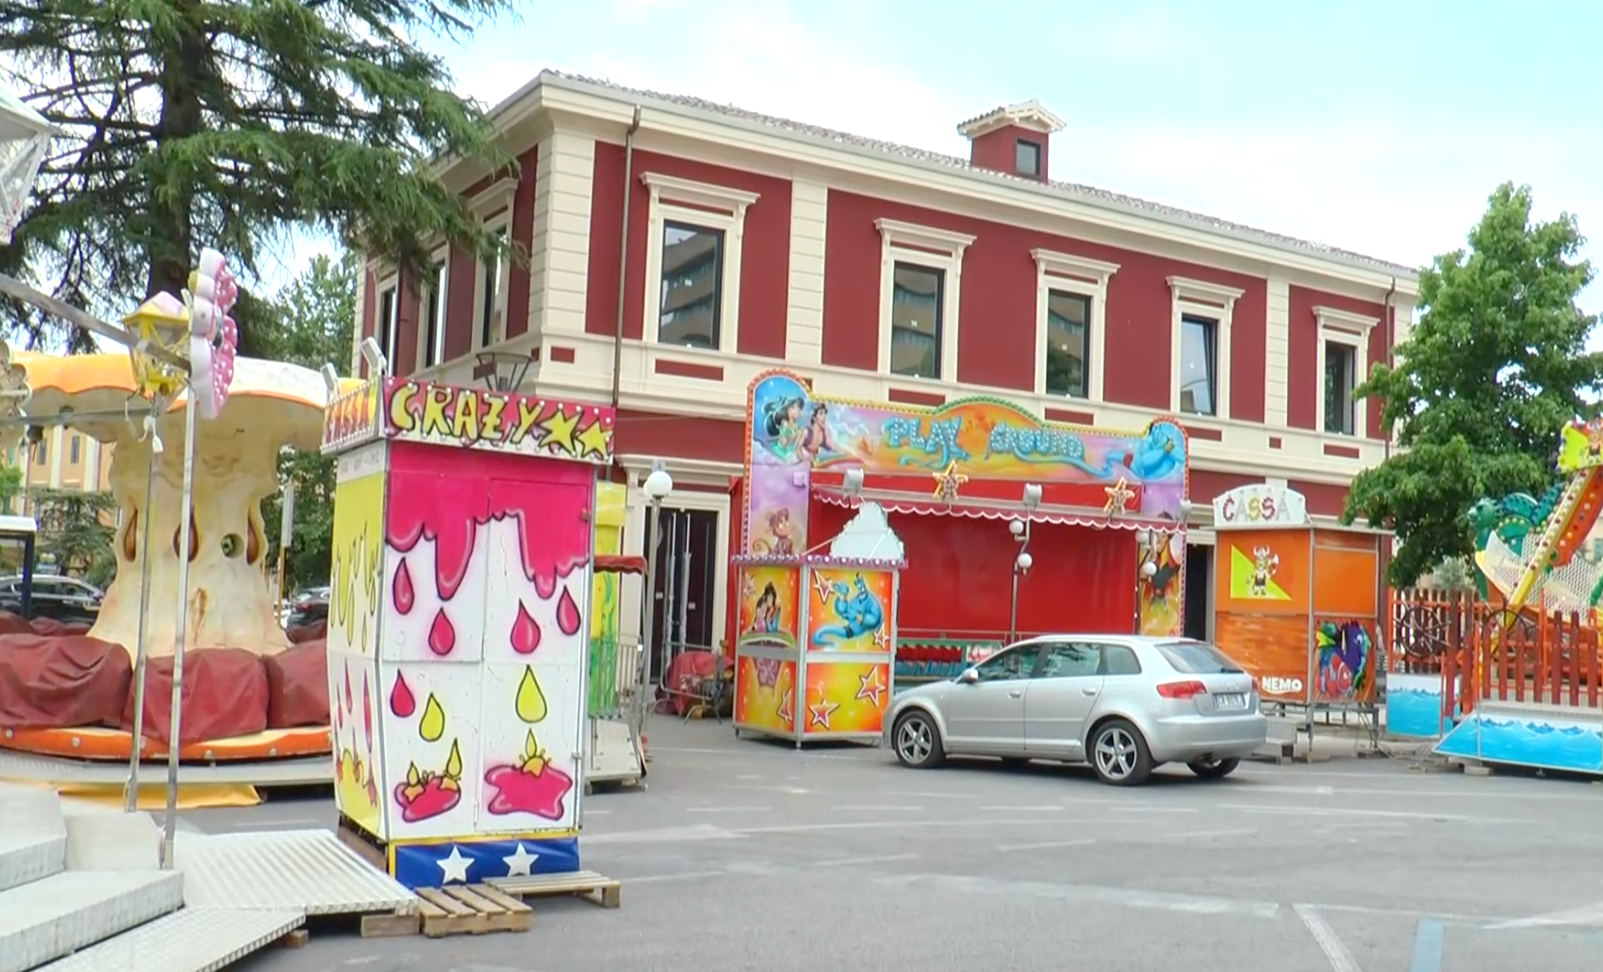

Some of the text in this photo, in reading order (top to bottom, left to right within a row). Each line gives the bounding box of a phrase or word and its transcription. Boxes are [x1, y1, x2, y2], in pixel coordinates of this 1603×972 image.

[390, 382, 545, 445] CRAZY
[880, 415, 1085, 461] PLAY GROUND
[1222, 496, 1290, 522] CASSA
[1261, 676, 1303, 694] NEMO
